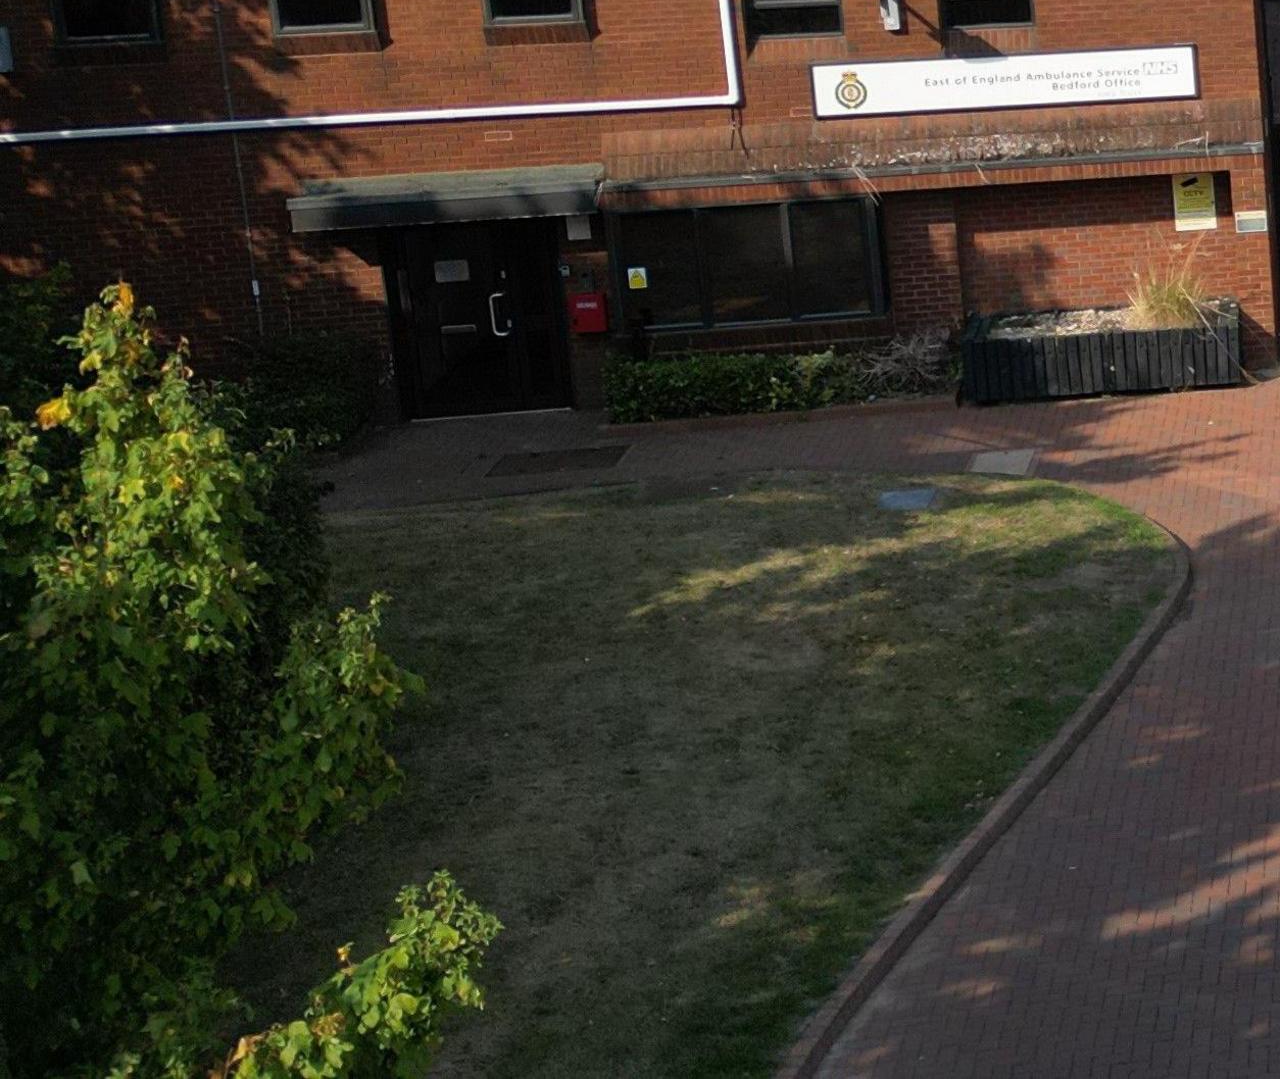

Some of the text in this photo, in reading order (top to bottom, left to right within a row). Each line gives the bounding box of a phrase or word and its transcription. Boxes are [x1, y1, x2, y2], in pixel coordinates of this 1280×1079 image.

[925, 67, 1140, 87] East of England Ambulance Service
[1052, 78, 1141, 91] Bedford Office
